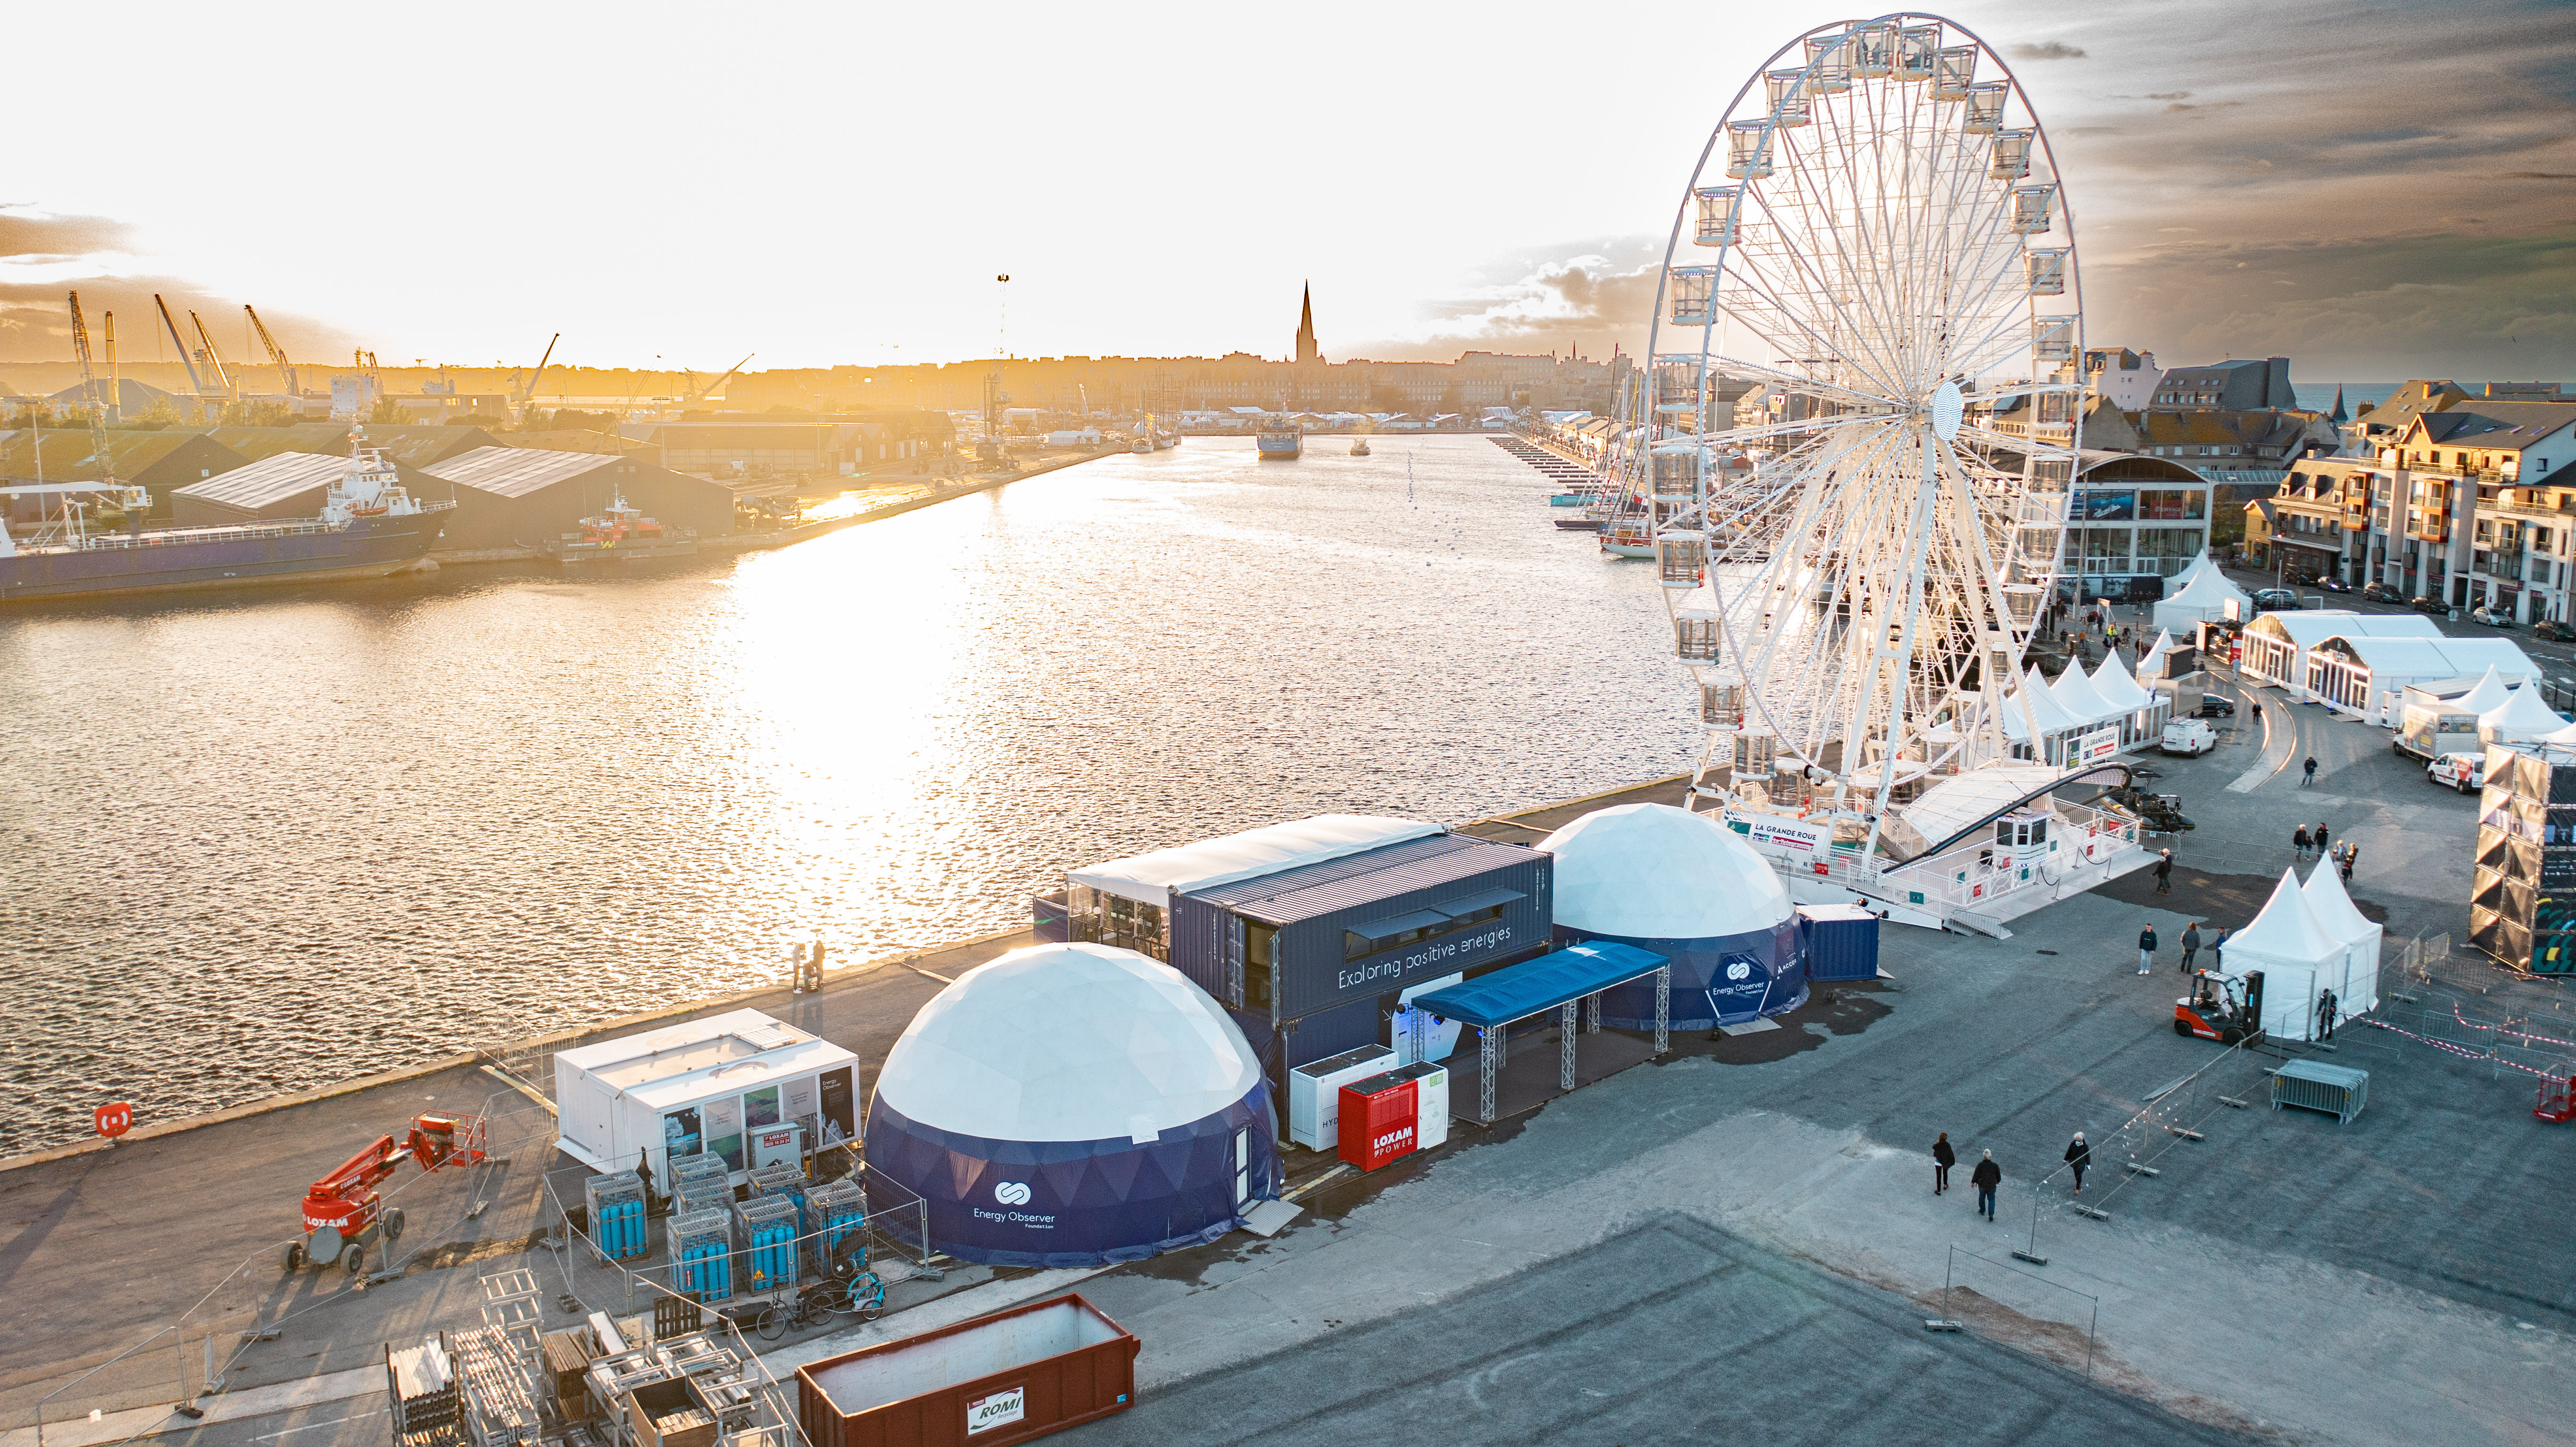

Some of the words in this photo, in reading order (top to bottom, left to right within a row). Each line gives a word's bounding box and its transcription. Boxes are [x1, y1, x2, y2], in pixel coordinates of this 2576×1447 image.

[2090, 736, 2105, 746] GRANDE
[2105, 733, 2115, 741] ROUE
[1767, 826, 1796, 836] GRANDE
[1797, 831, 1817, 840] ROUE
[1339, 960, 1400, 989] Exploring
[1406, 943, 1455, 974] positive
[1461, 927, 1511, 952] energies
[1782, 959, 1797, 970] ACCOR
[1713, 987, 1734, 995] Energy
[1735, 982, 1764, 991] Observer
[1323, 1117, 1338, 1128] HYD
[1374, 1126, 1412, 1149] LOXAM
[1379, 1138, 1412, 1156] POWER
[344, 1175, 361, 1188] LOXAM
[307, 1216, 349, 1227] LOXAM
[974, 1208, 1006, 1223] Energy
[1008, 1212, 1055, 1223] Observer
[979, 1397, 1022, 1420] ROMI
[997, 1410, 1018, 1419] Recyclage
